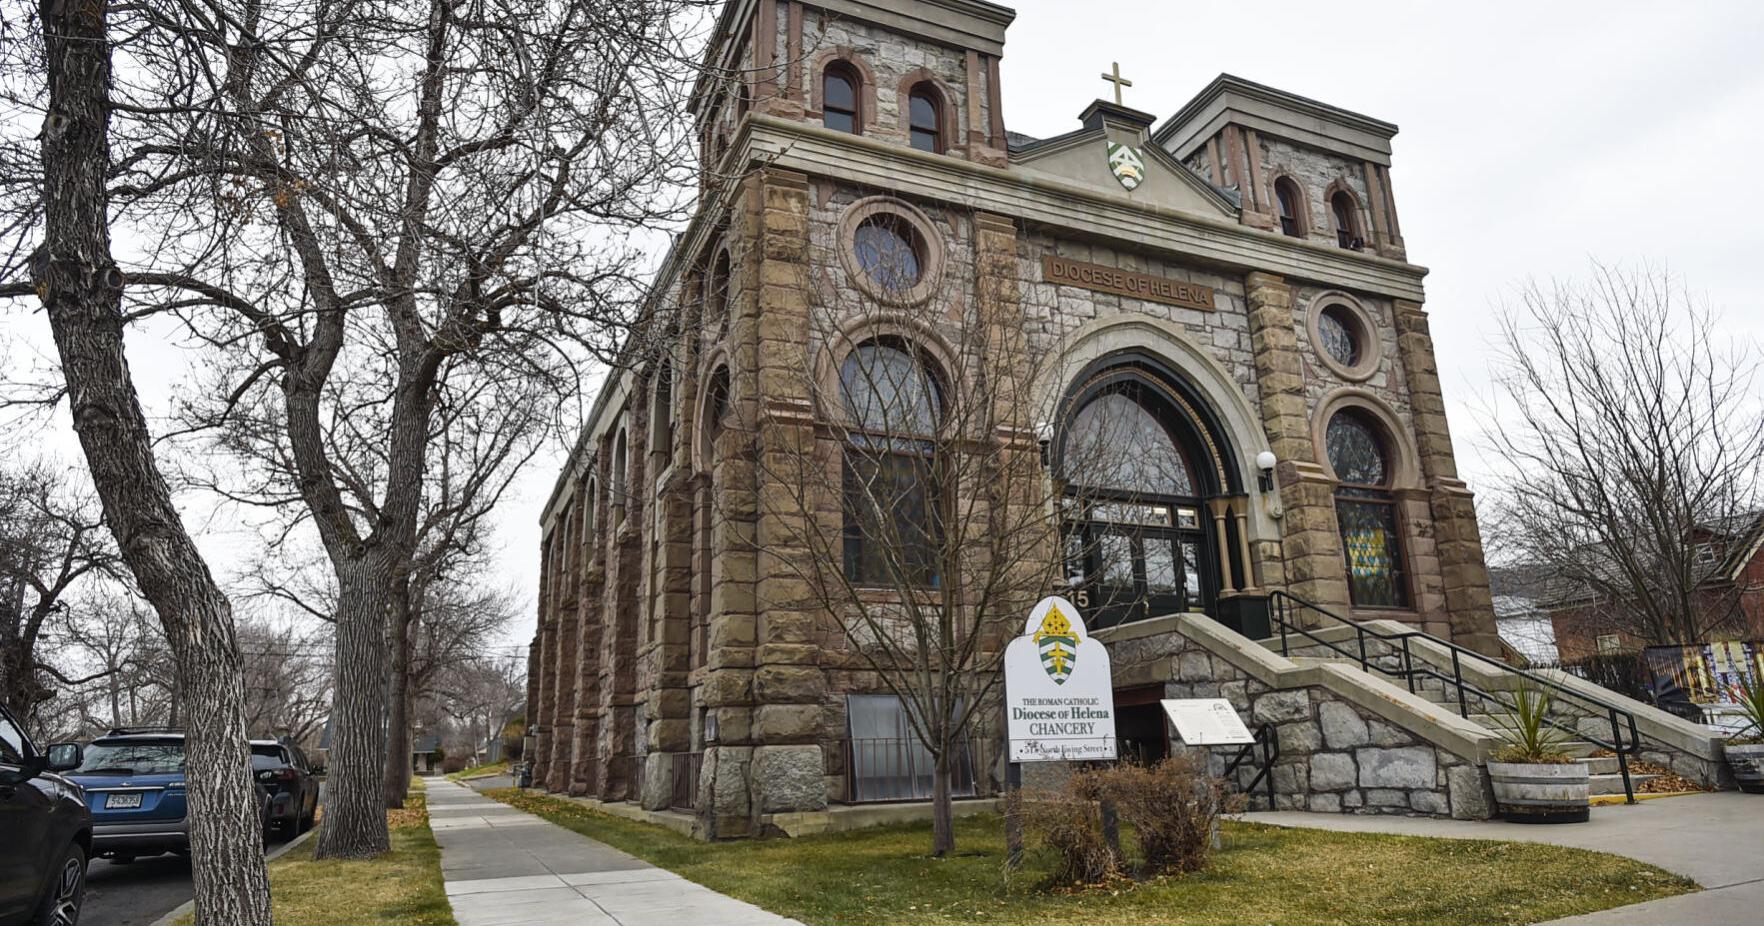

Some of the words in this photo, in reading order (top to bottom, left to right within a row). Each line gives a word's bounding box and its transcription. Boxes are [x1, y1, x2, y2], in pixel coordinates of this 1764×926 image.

[1053, 262, 1123, 289] DIOCESE
[1125, 277, 1148, 293] OF
[1150, 279, 1209, 304] HELENA
[1022, 698, 1036, 706] THE
[1037, 698, 1062, 706] ROMAN
[1064, 698, 1099, 706] CATHOLIC
[1013, 707, 1057, 720] Diocese
[1058, 710, 1070, 720] OF
[1071, 706, 1109, 719] Helena
[1029, 722, 1095, 735] CHANCERY
